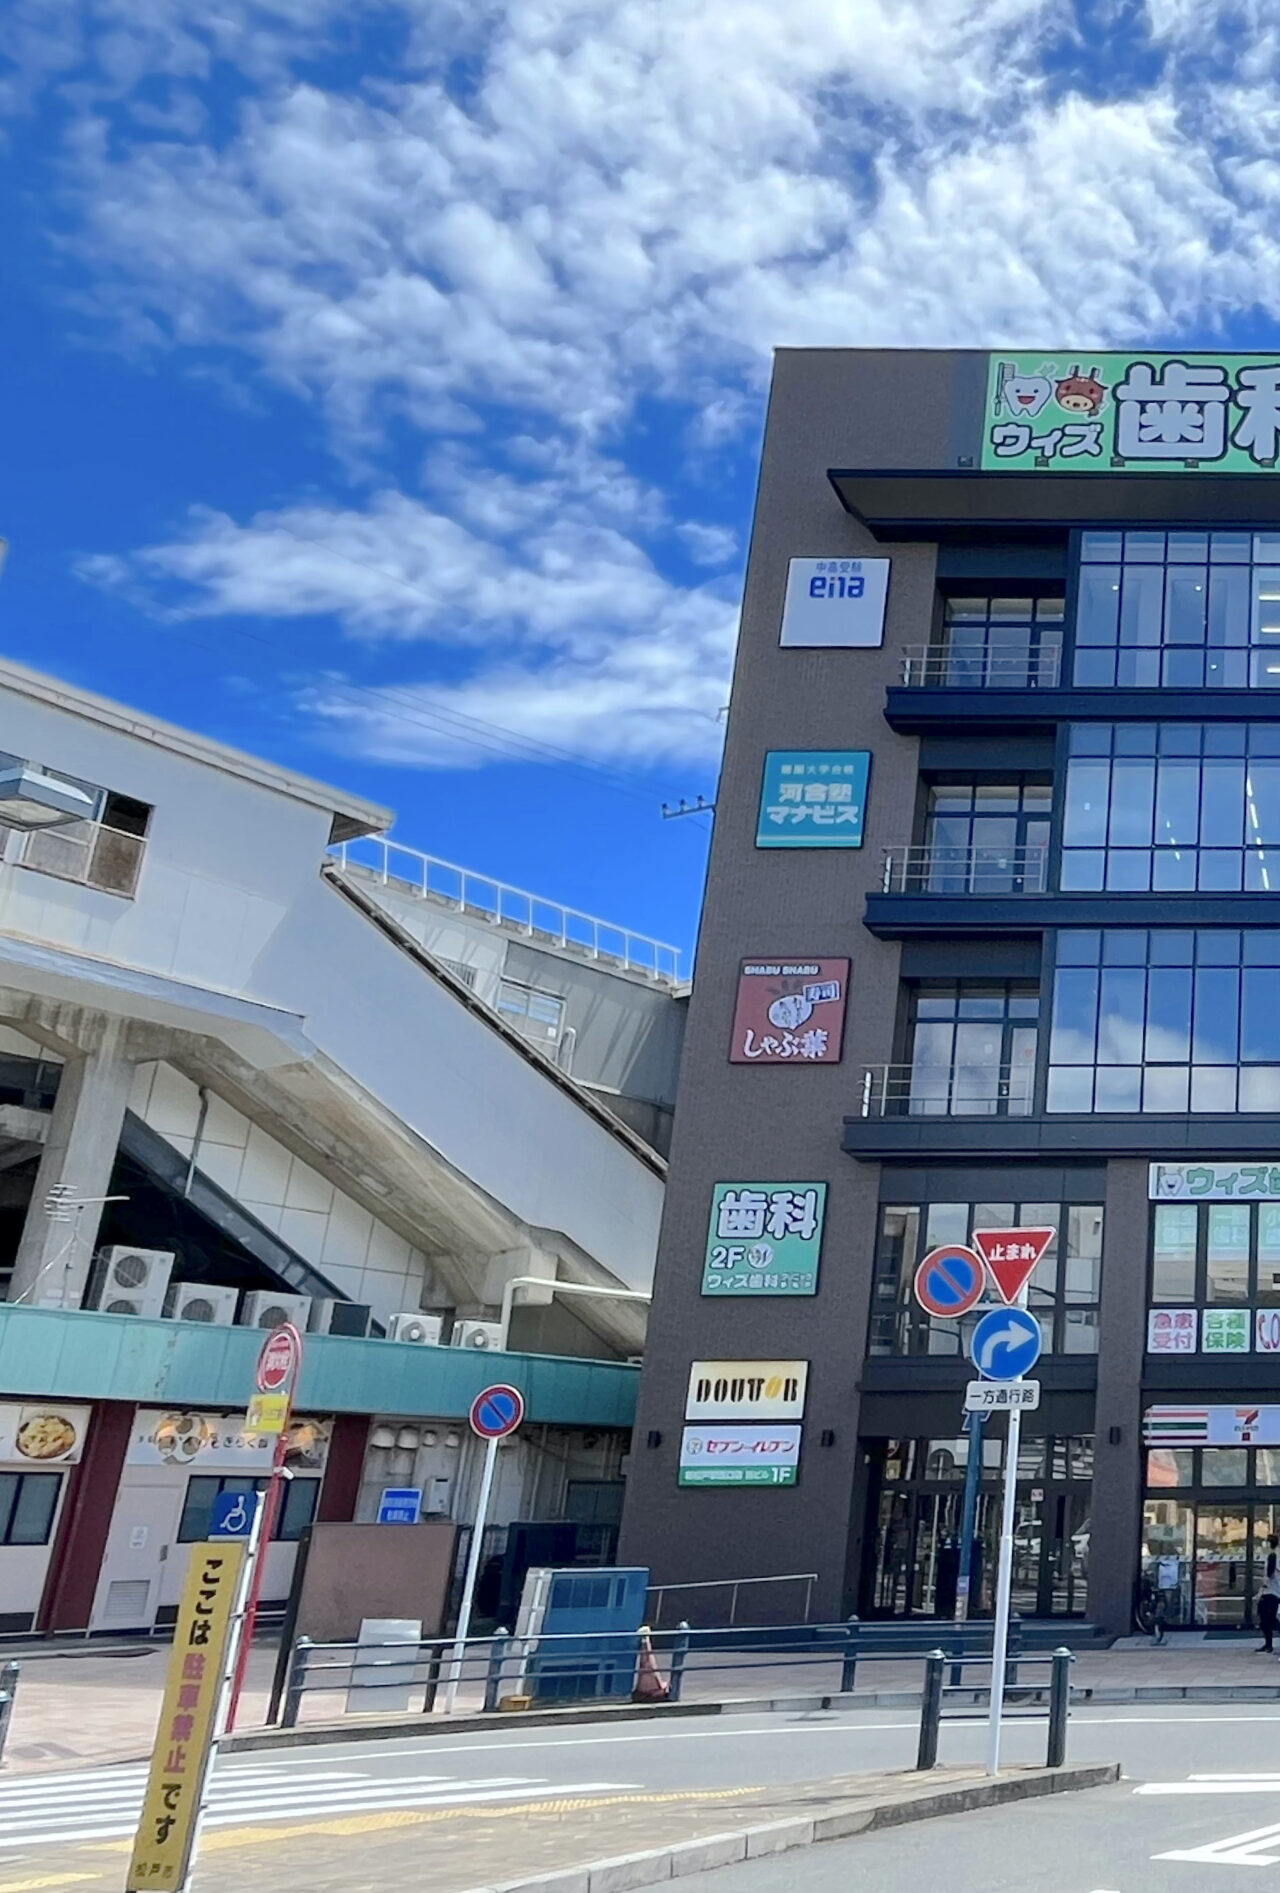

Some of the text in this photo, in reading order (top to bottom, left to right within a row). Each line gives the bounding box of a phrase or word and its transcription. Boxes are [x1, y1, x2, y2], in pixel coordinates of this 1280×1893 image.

[991, 422, 1103, 458] ウィズ
[809, 576, 865, 598] ena
[778, 783, 852, 802] 河合塾
[766, 805, 858, 824] マナビス
[743, 1028, 829, 1059] しゃぶ葉
[717, 1188, 818, 1240] 歯科
[709, 1245, 746, 1269] 2F
[988, 1242, 1037, 1262] 止まれ
[1153, 1331, 1194, 1349] 受付
[1205, 1331, 1247, 1349] 保険
[696, 1376, 798, 1402] DOUTOR
[969, 1388, 1035, 1404] 一方通行路
[771, 1467, 792, 1482] 1F
[154, 1557, 224, 1846] ここは駐車禁止です
